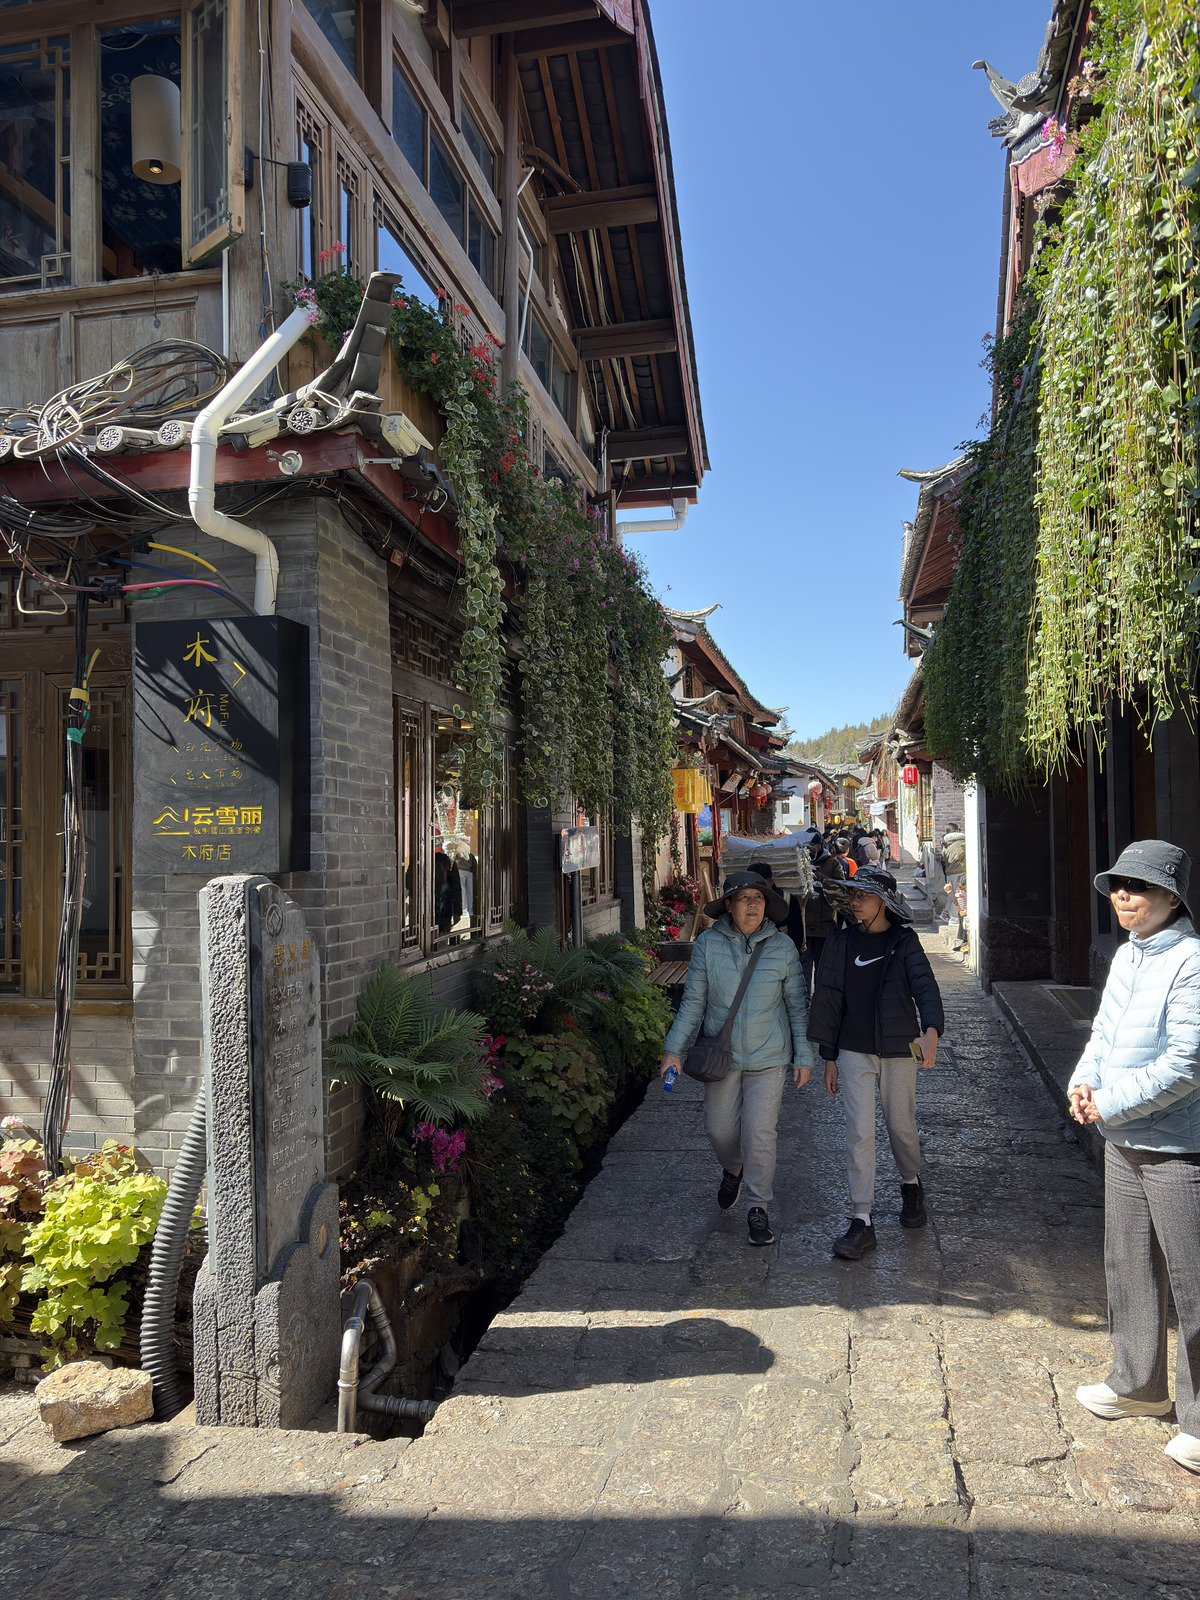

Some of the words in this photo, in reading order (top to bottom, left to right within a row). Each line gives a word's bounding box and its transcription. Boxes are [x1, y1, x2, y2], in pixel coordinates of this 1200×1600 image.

[183, 631, 218, 727] 木府
[220, 693, 229, 727] MuFu
[191, 806, 263, 826] 云雪丽
[181, 844, 232, 861] 木府店
[277, 1014, 298, 1033] 木府
